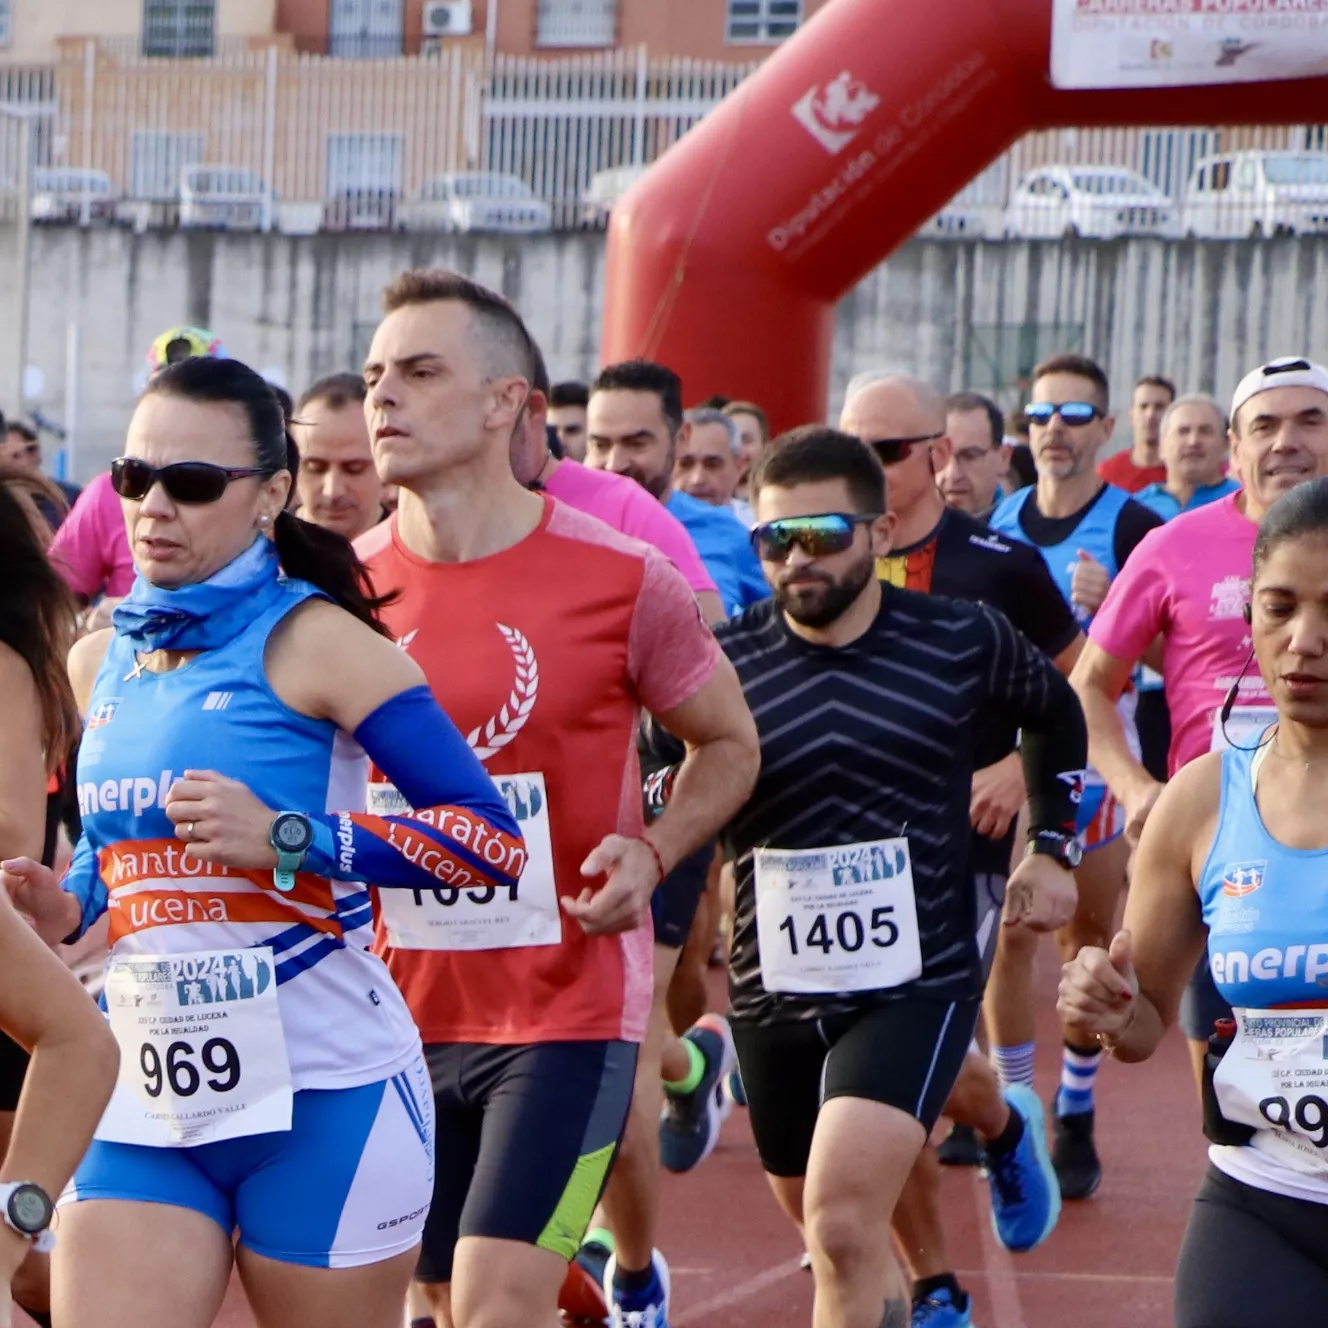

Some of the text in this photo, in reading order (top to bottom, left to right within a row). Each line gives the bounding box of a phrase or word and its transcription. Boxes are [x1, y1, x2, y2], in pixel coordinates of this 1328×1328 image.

[779, 906, 899, 955] 1405
[172, 956, 227, 980] 2024
[185, 1014, 195, 1022] DE
[197, 1011, 229, 1021] LUCENA
[161, 1027, 170, 1035] LA
[140, 1037, 241, 1098] 969
